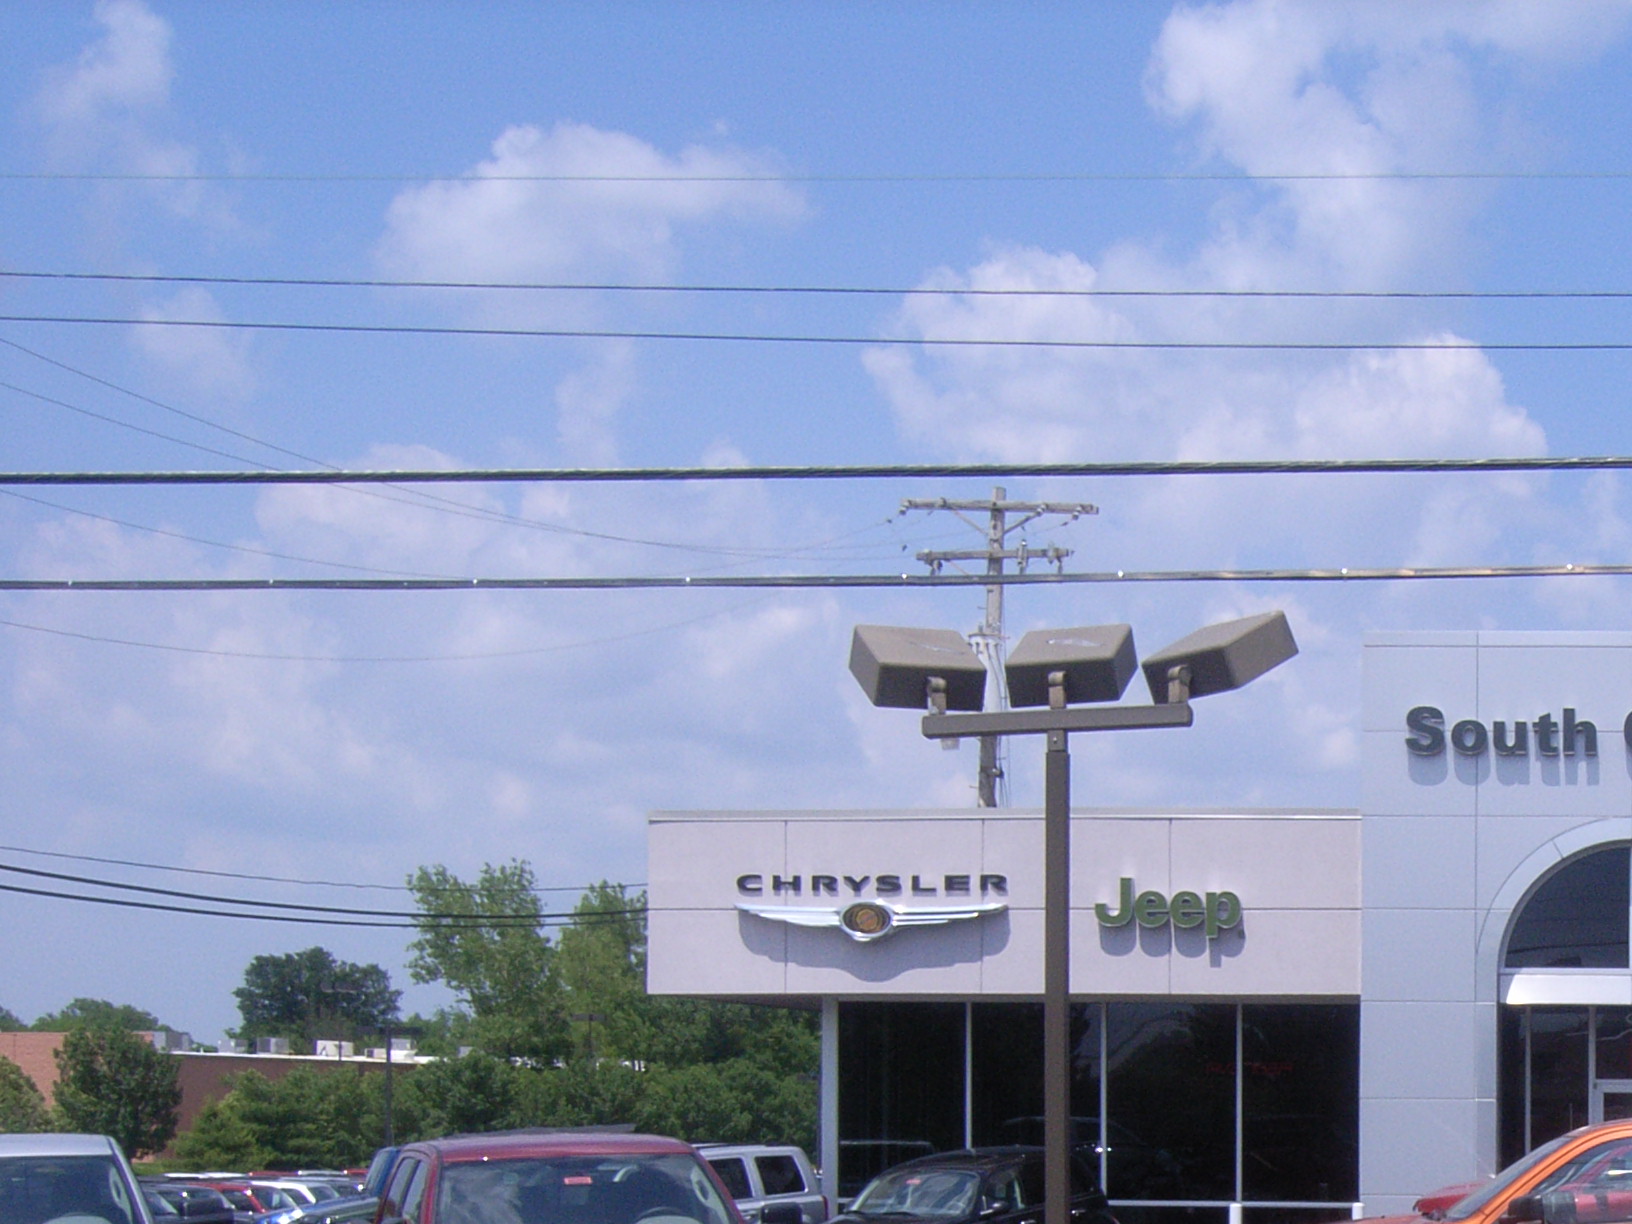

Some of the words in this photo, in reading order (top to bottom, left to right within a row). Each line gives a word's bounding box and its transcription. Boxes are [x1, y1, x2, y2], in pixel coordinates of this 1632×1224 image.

[1404, 705, 1597, 757] South
[736, 874, 1009, 892] CHRYSLER
[1094, 877, 1242, 939] Jeep
